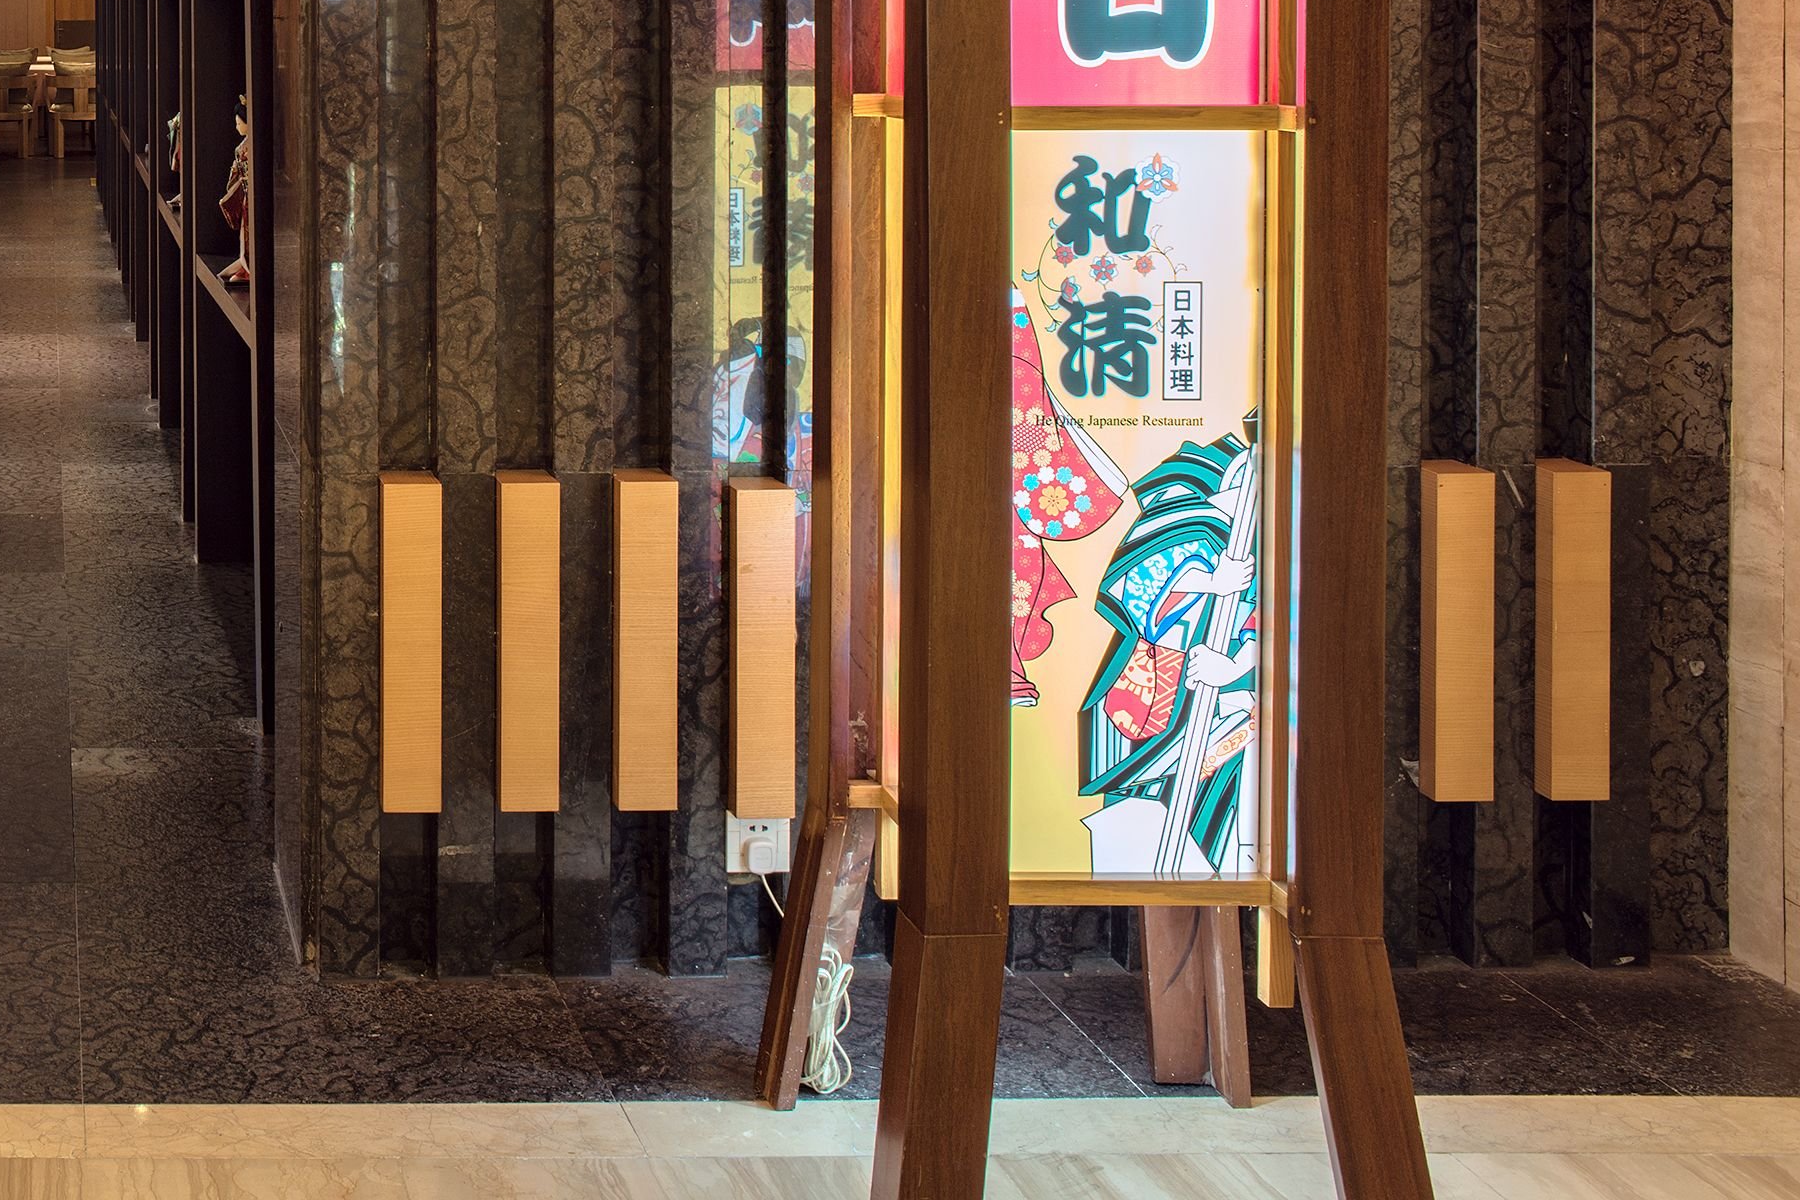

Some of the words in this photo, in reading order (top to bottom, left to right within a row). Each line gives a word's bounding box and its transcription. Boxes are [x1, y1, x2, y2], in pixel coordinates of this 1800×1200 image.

[1054, 154, 1158, 398] 和清
[1169, 288, 1195, 393] 日本料理
[1036, 415, 1053, 427] He
[1055, 415, 1084, 429] Qing
[1087, 415, 1138, 429] Japanese
[1142, 415, 1204, 427] Restaurant
